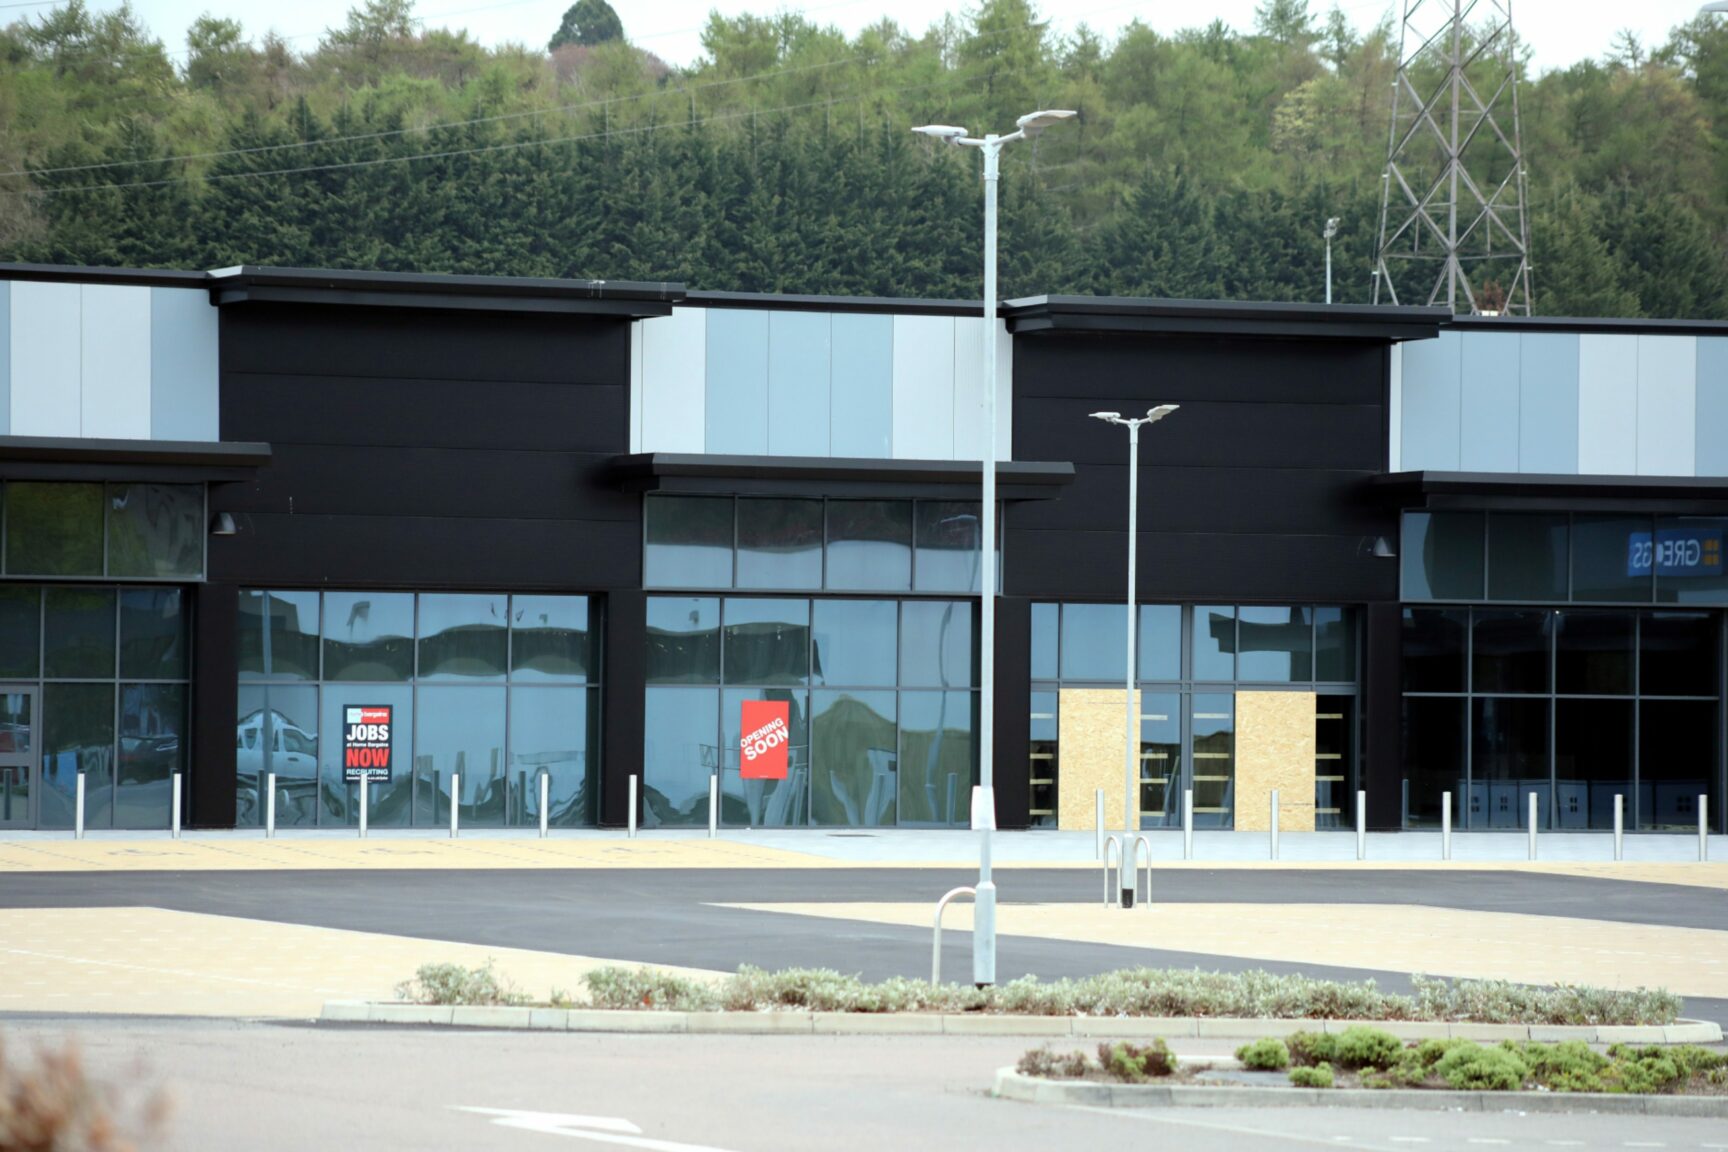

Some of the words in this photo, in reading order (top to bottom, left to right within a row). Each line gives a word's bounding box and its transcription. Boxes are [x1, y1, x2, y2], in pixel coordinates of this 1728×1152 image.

[346, 724, 389, 741] JOBS
[740, 717, 784, 747] OPENING
[744, 726, 789, 760] SOON
[346, 748, 390, 768] NOW
